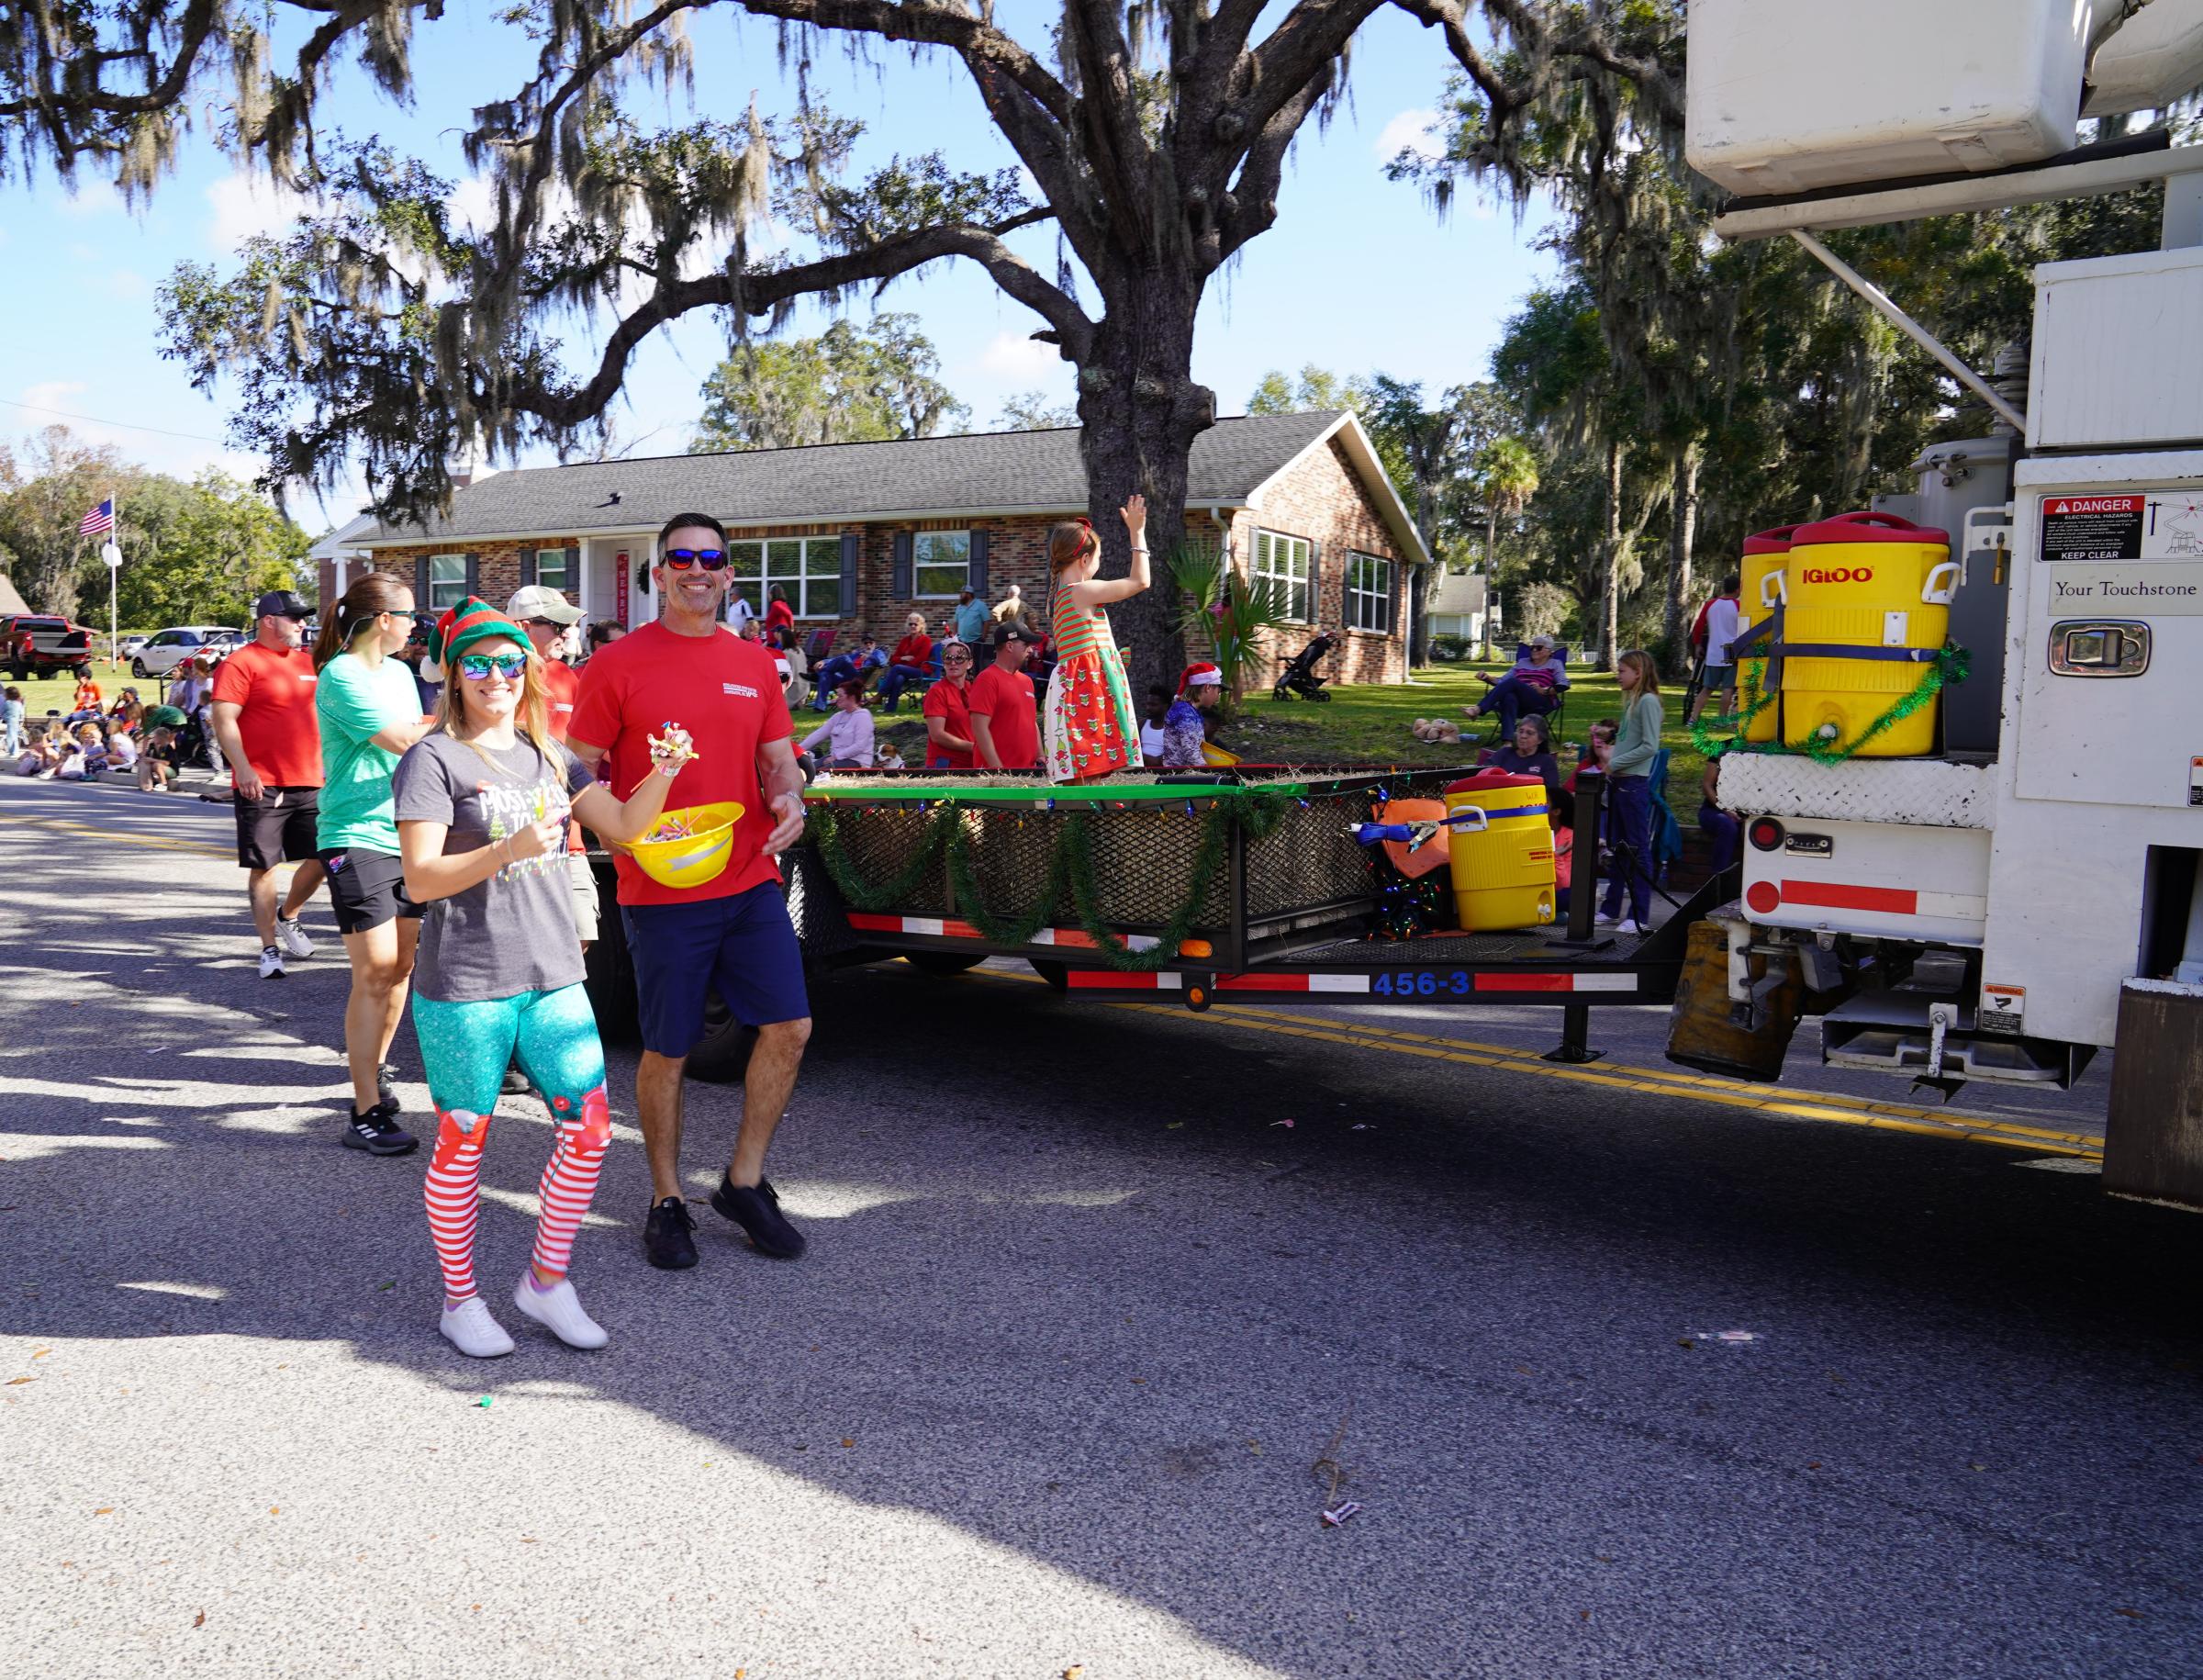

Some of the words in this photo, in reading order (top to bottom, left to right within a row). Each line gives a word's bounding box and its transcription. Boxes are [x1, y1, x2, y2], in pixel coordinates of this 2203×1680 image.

[2073, 499, 2131, 512] DANGER
[1802, 567, 1873, 584] IGLOO
[2056, 581, 2094, 596] Your
[2099, 581, 2197, 596] Touchstone
[478, 786, 528, 822] MOST
[1374, 971, 1470, 995] 456-3
